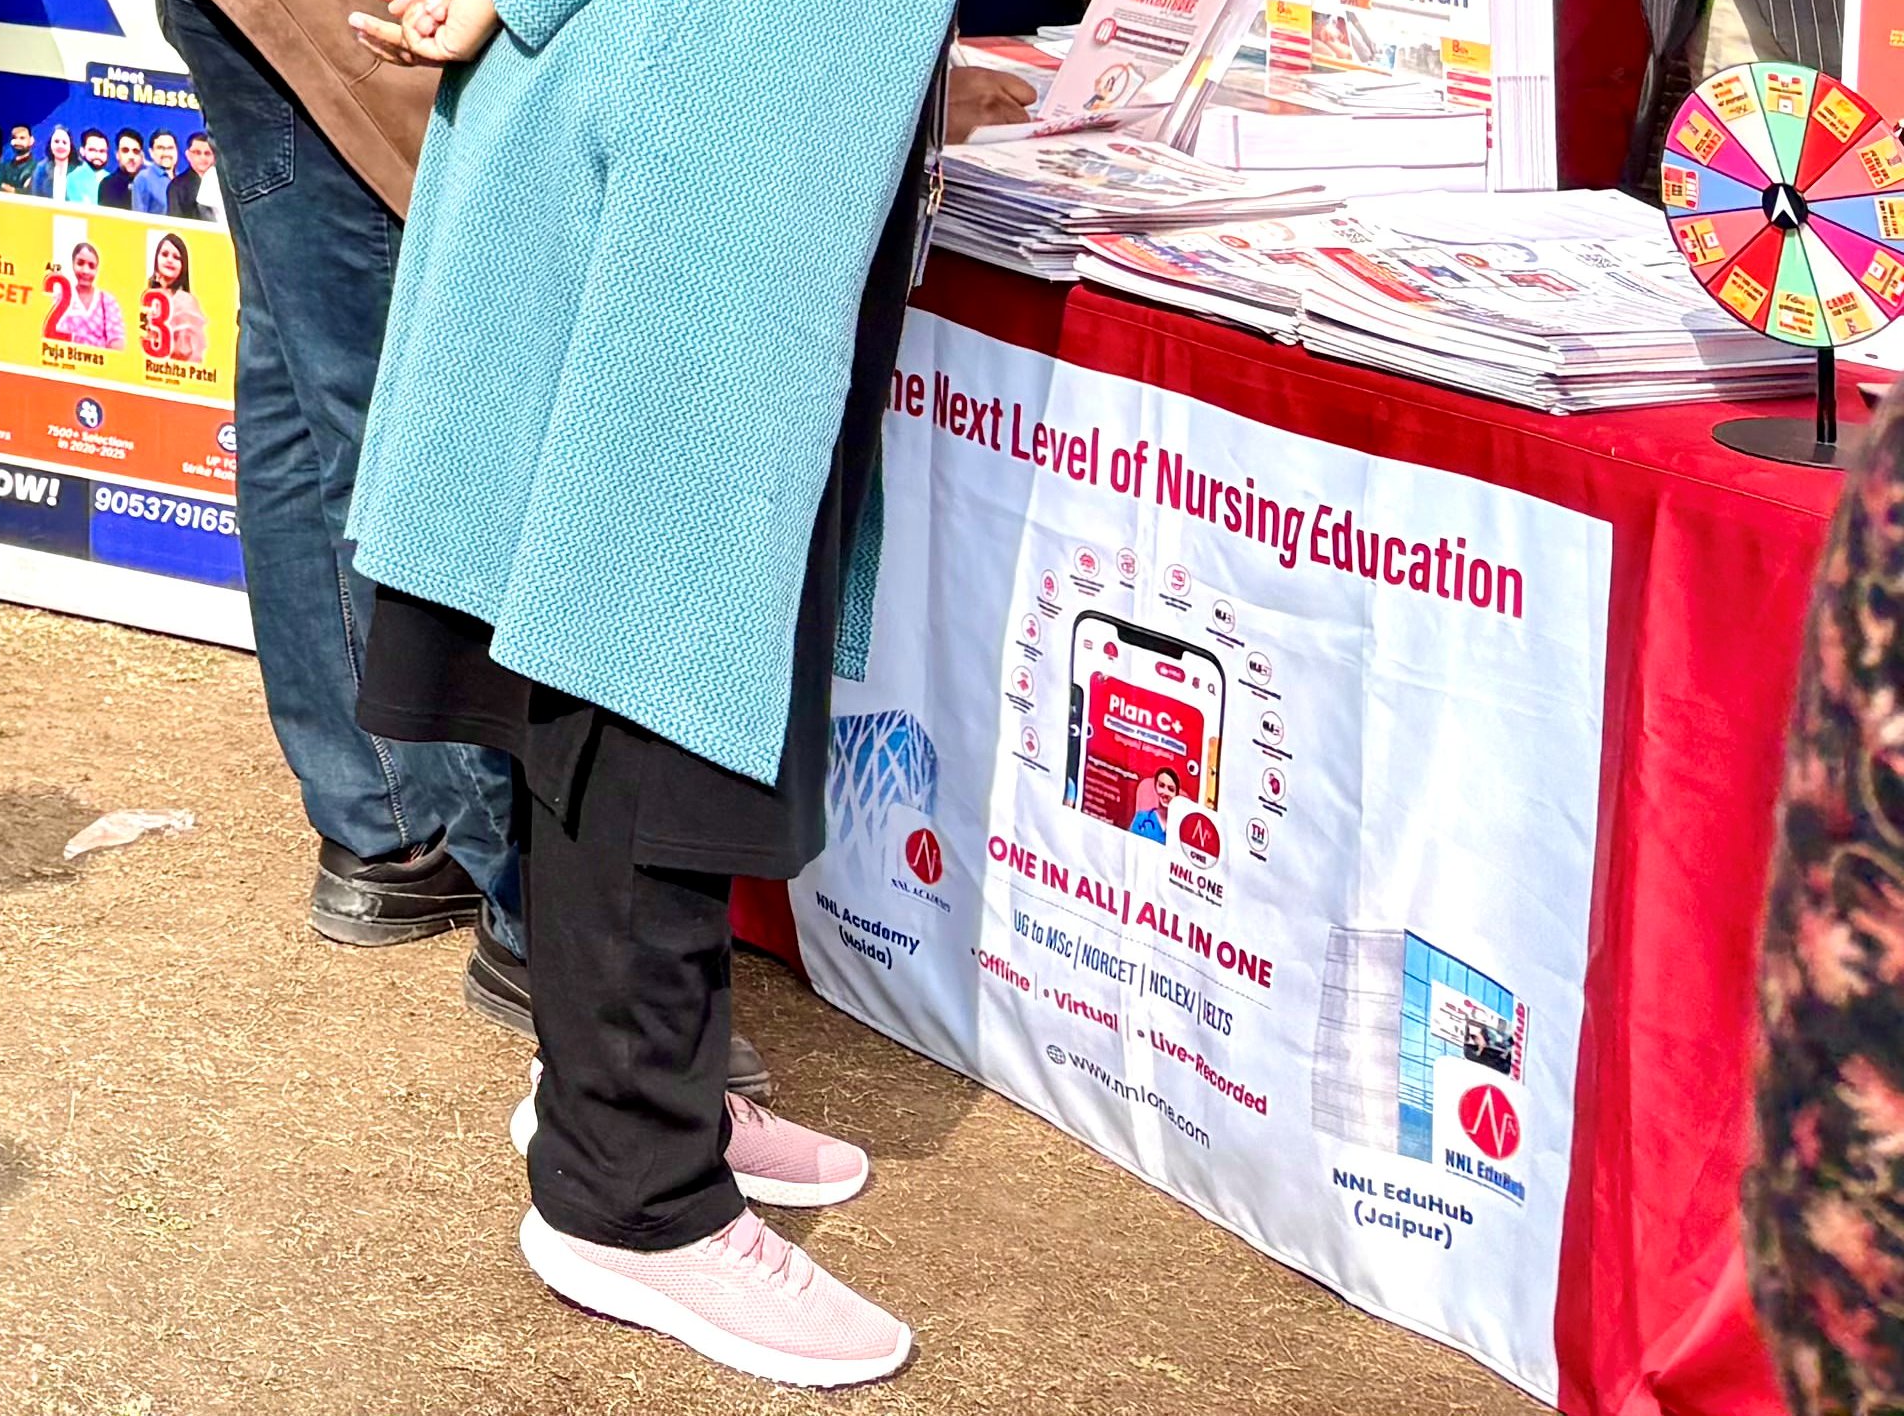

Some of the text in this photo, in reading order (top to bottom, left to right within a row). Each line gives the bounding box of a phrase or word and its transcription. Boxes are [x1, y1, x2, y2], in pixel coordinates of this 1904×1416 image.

[91, 77, 130, 101] The
[107, 67, 145, 85] Meet
[43, 274, 73, 343] 2
[141, 290, 171, 359] 3
[42, 342, 65, 360] Puja
[67, 347, 105, 366] Biswas
[145, 359, 186, 379] Ruchita
[189, 366, 217, 383] Patel
[47, 424, 135, 451] 7500+ Selections
[57, 438, 126, 460] in 2020-2025
[94, 486, 241, 536] 905379165
[887, 368, 1523, 619] he Next Level of Nursing Education
[1109, 693, 1184, 734] Plan C+
[1170, 861, 1194, 885] NNL
[1197, 875, 1224, 899] ONE
[816, 891, 921, 955] NNL Academy
[988, 834, 1273, 989] ONE IN ALL ALL IN ONE
[839, 924, 893, 970] (Noida)
[1013, 908, 1029, 933] UG
[1031, 922, 1043, 944] to
[1045, 925, 1073, 959] MSc
[1081, 940, 1138, 986] NORCET
[1203, 997, 1234, 1037] IELTS
[978, 950, 1268, 1117] Offline Virtual Live-Recorded
[1068, 1051, 1210, 1150] www.nnlone.com
[1332, 1167, 1475, 1226] NNL EduHub
[1445, 1148, 1526, 1202] NNL EduHub
[1354, 1200, 1453, 1250] (Jaipur)
